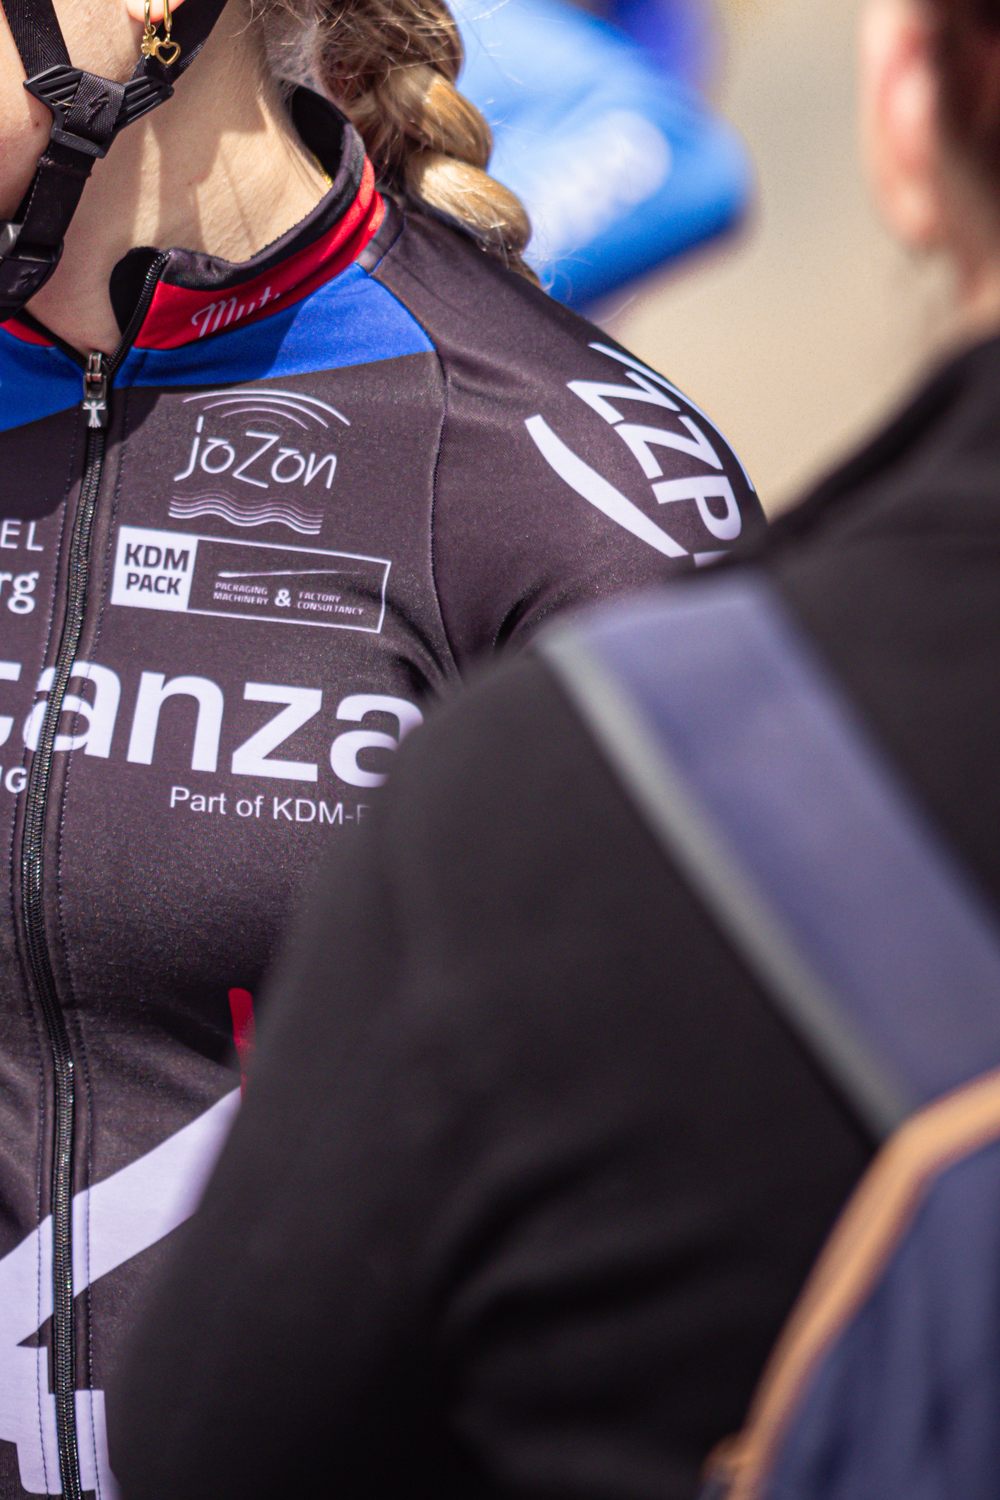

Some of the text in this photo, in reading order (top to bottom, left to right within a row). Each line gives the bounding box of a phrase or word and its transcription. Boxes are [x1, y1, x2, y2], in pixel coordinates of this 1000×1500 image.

[124, 542, 191, 573] KDM
[125, 572, 182, 596] PACK
[214, 581, 268, 596] PACKAGING
[212, 592, 270, 606] MACHINERY
[274, 588, 292, 607] &
[298, 591, 342, 603] FACTORY
[296, 601, 365, 616] CONSULTANCY
[169, 786, 227, 815] Part
[235, 795, 264, 818] of
